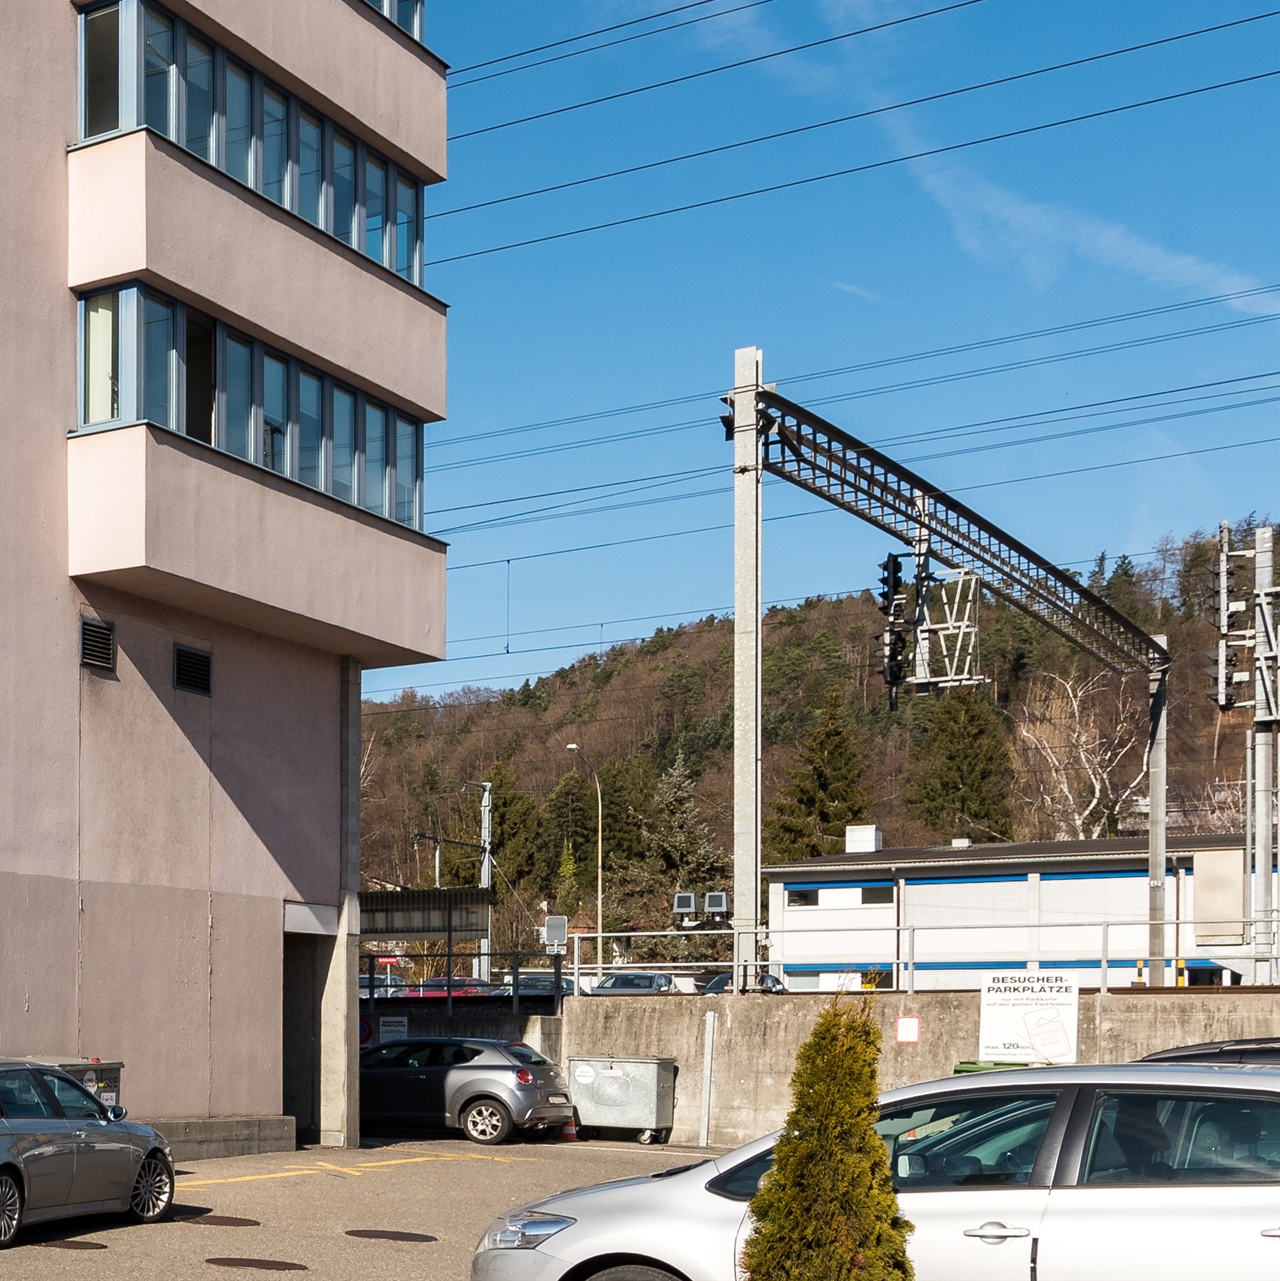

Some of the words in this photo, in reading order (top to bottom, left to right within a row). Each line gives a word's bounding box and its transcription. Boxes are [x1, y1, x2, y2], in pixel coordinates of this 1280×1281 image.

[992, 976, 1068, 984] BESUCHER-
[987, 984, 1073, 993] PARKPLÄTZE
[1002, 1042, 1019, 1050] 120
